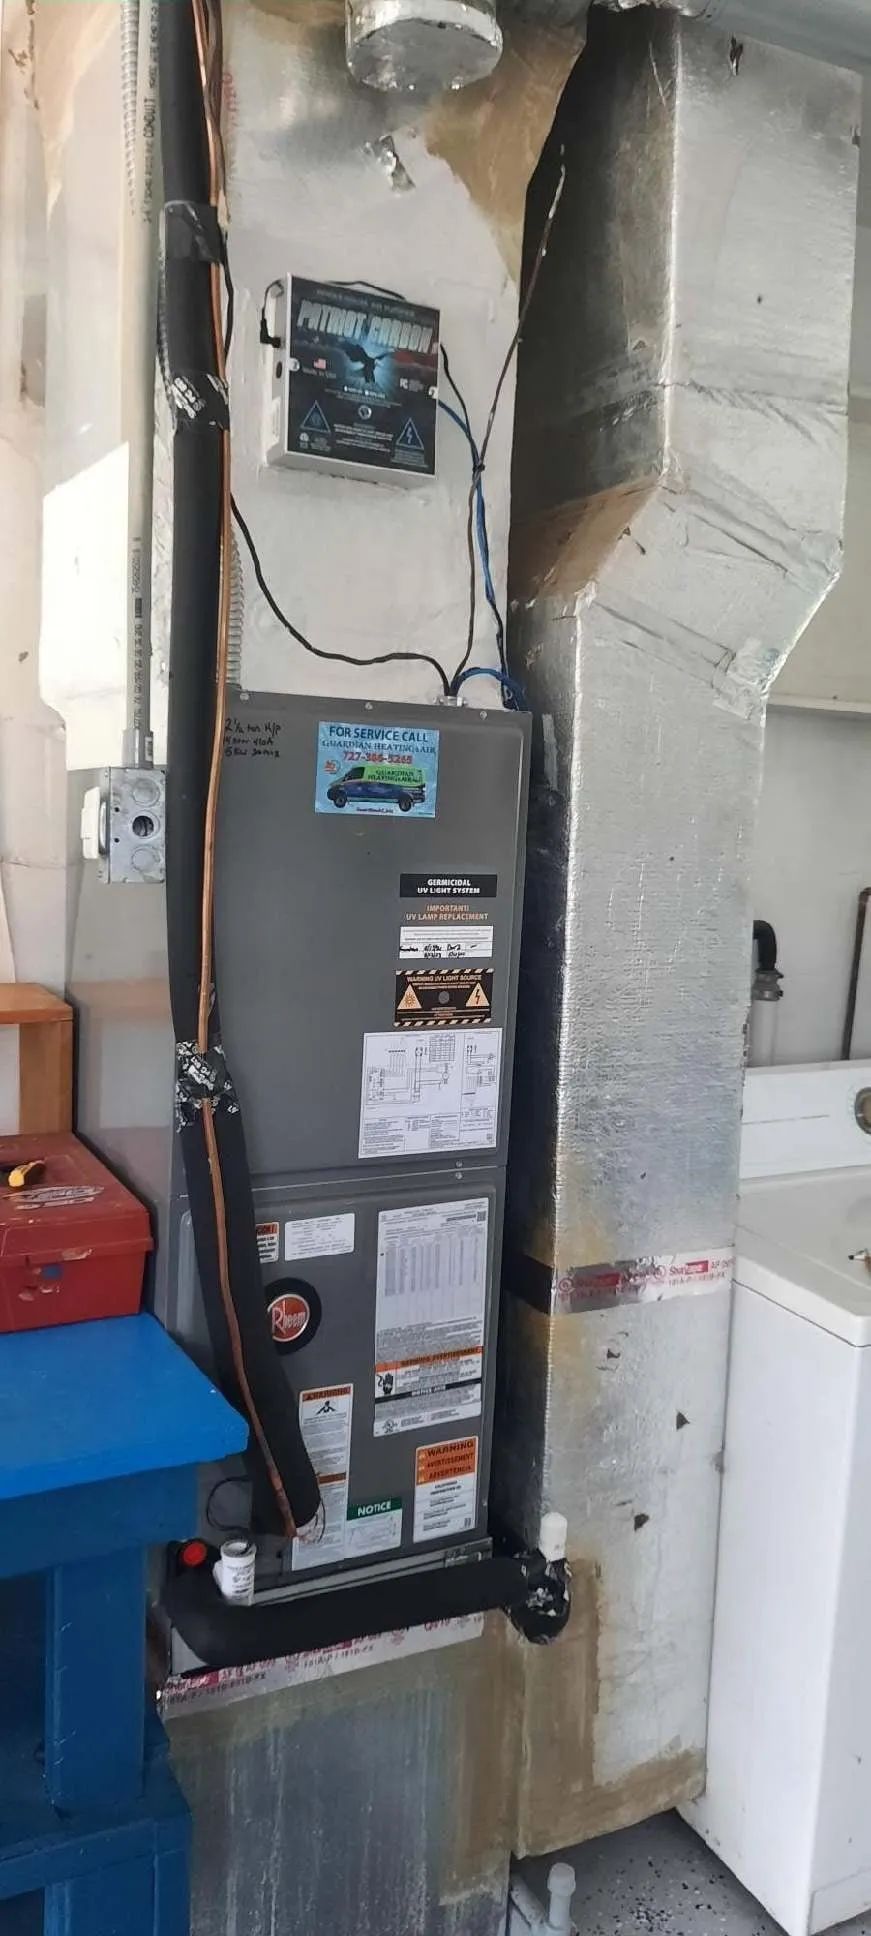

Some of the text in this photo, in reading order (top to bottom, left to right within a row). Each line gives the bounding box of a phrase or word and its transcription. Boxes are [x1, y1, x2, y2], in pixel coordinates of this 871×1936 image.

[143, 97, 156, 138] CONDUIT
[296, 300, 367, 340] PATRIOT
[329, 726, 428, 742] FOR SERVICE CALL
[322, 740, 371, 750] GUARDIAN
[406, 913, 488, 921] UV LAMP REPLACEMENT
[272, 1299, 306, 1335] Rheem
[427, 1440, 473, 1456] WARNING
[357, 1500, 392, 1517] NOTICE
